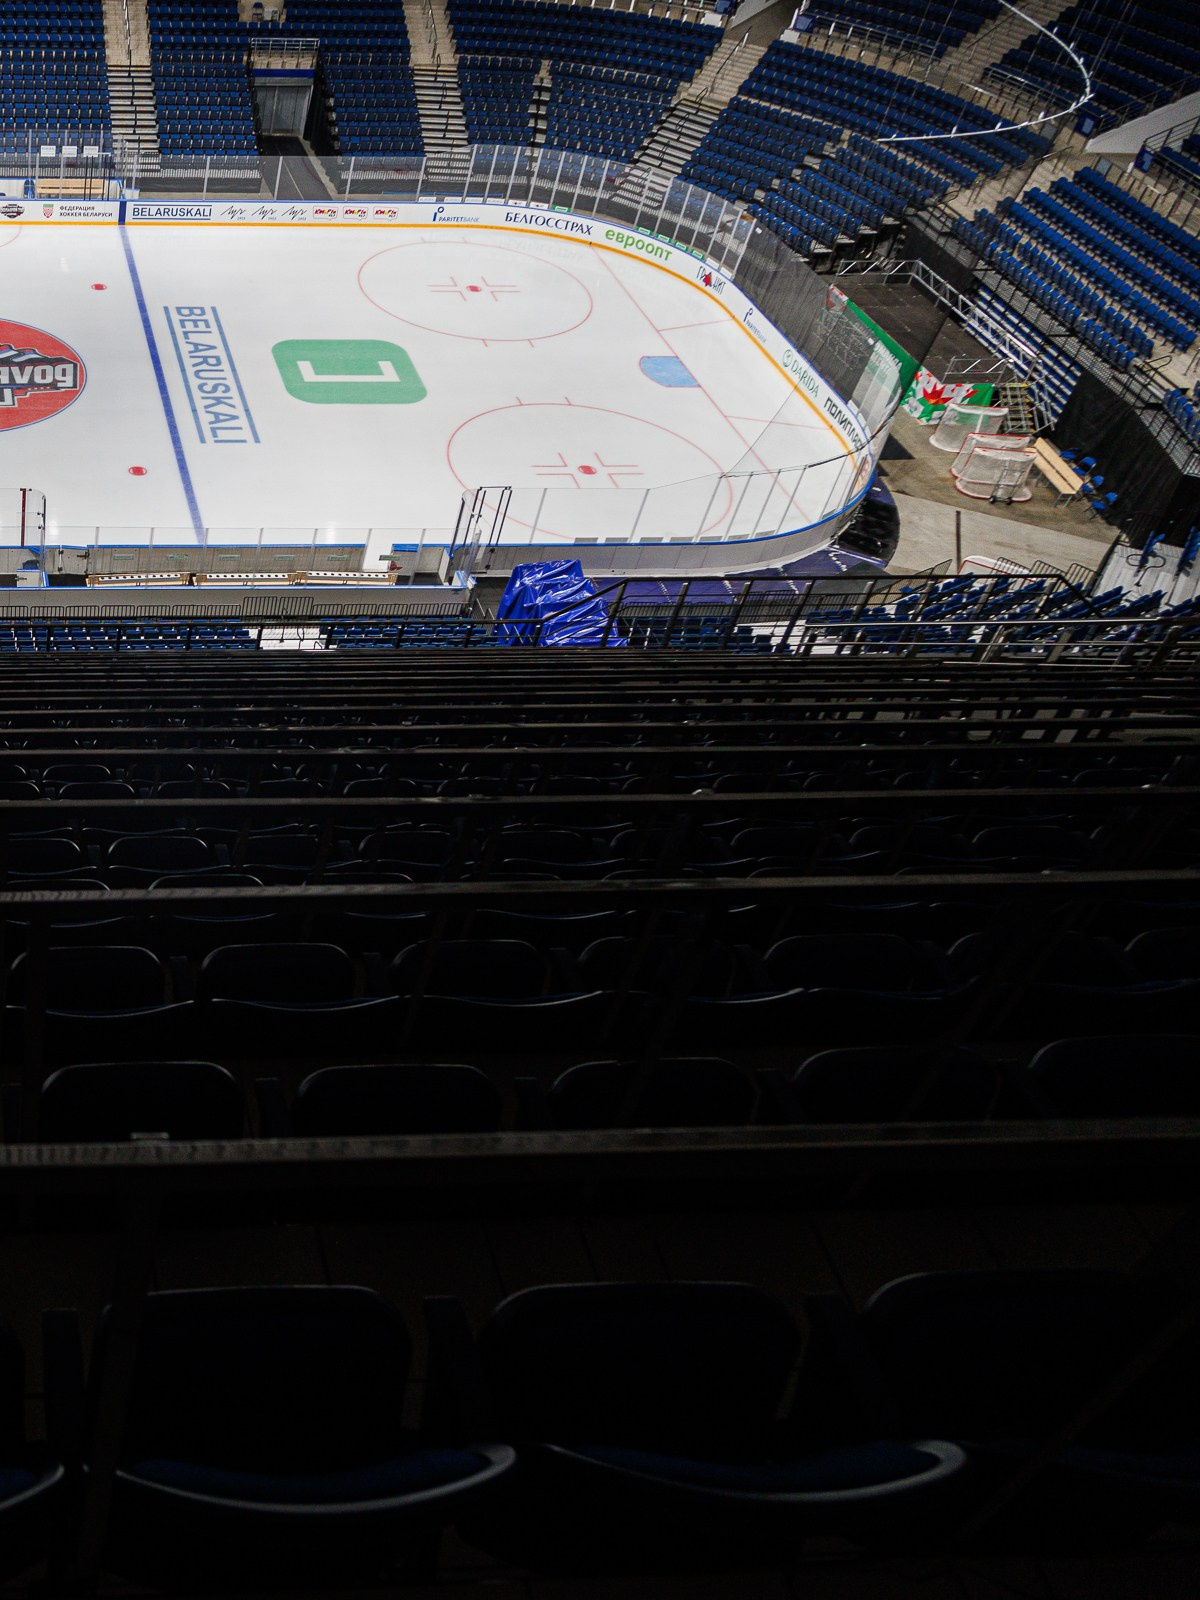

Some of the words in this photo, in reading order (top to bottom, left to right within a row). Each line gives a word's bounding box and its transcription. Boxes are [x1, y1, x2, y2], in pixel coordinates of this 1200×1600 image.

[132, 207, 212, 217] BELARUSKALI
[505, 212, 594, 236] БЕЛГОССТРАХ
[604, 228, 673, 261] евроопт
[175, 306, 248, 443] BELARUSKALI
[790, 359, 820, 398] DARIDA
